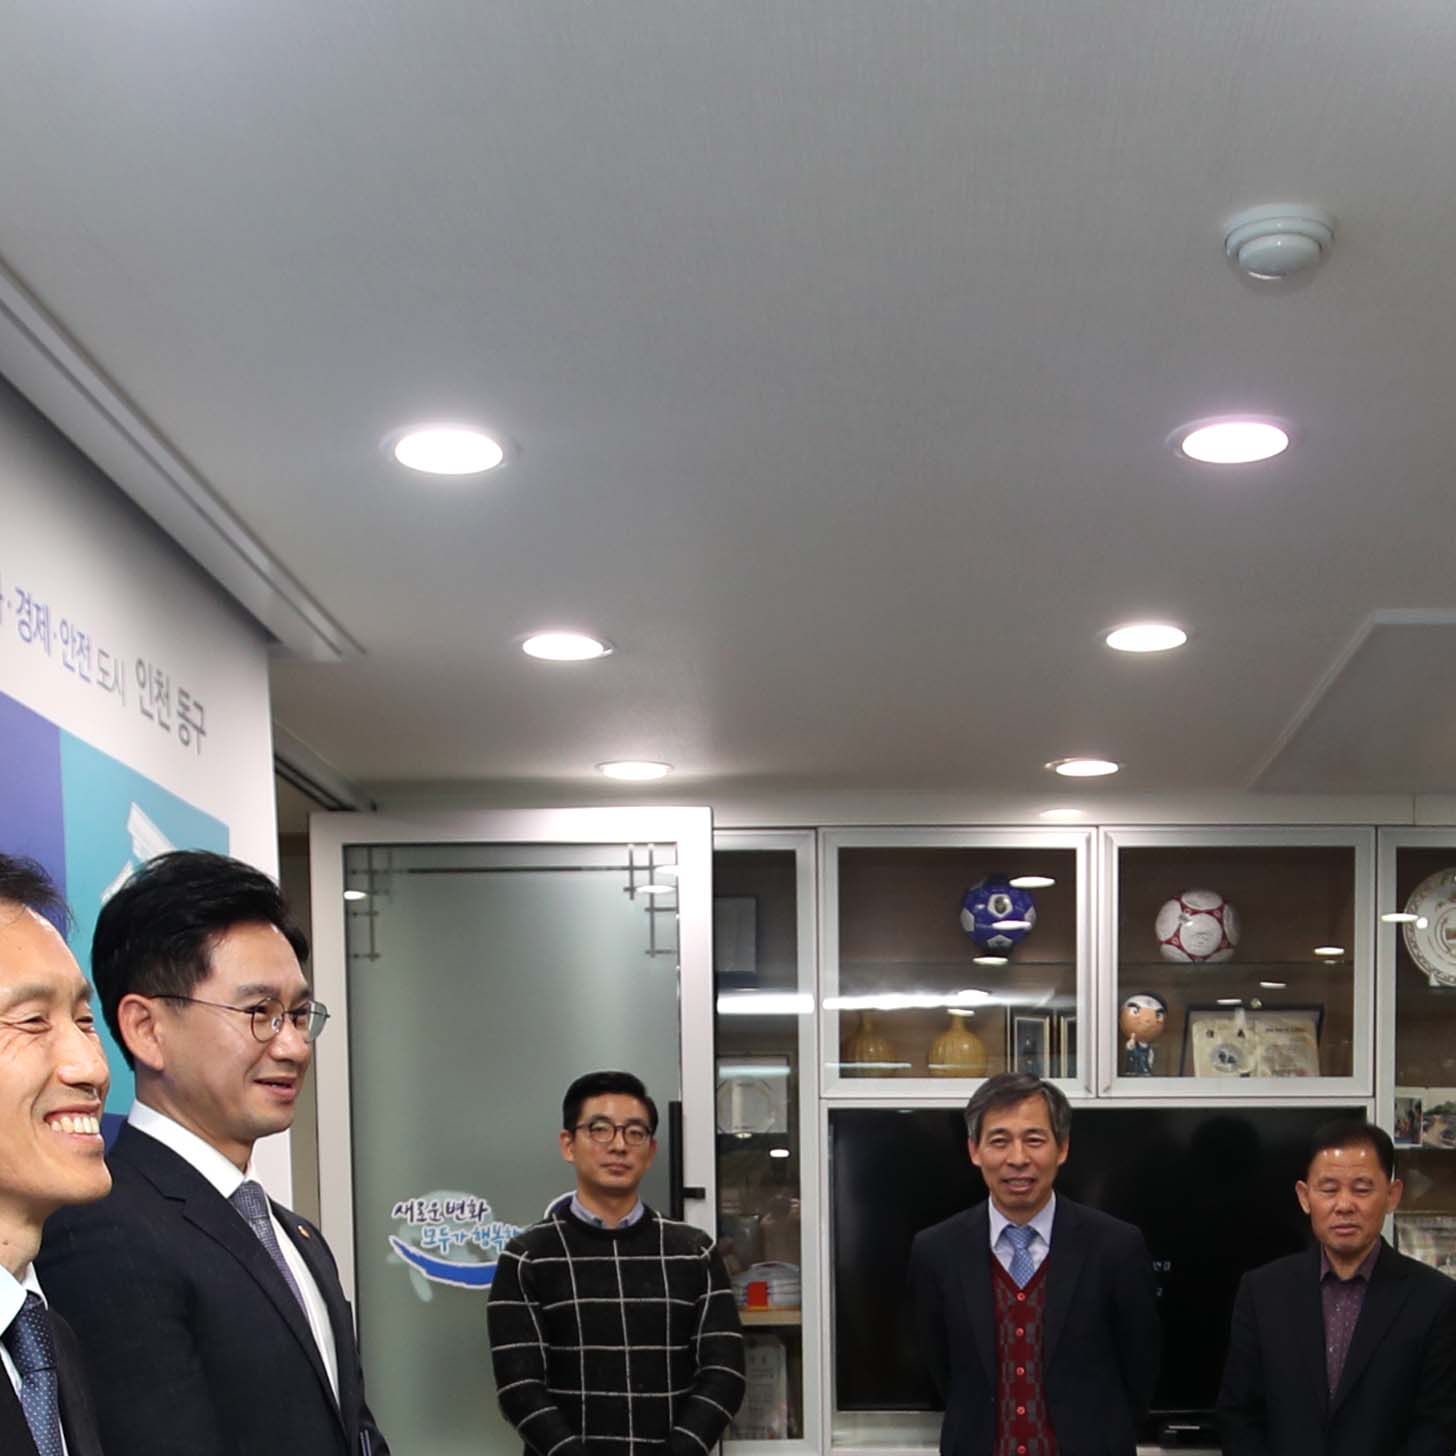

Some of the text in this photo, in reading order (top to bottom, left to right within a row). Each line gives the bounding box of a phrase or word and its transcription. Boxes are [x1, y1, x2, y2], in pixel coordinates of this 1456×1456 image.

[97, 648, 127, 707] 도시
[136, 658, 171, 732] 인천
[177, 686, 207, 755] 동구
[395, 1199, 488, 1222] 새로운 변화
[422, 1225, 466, 1251] 모두가
